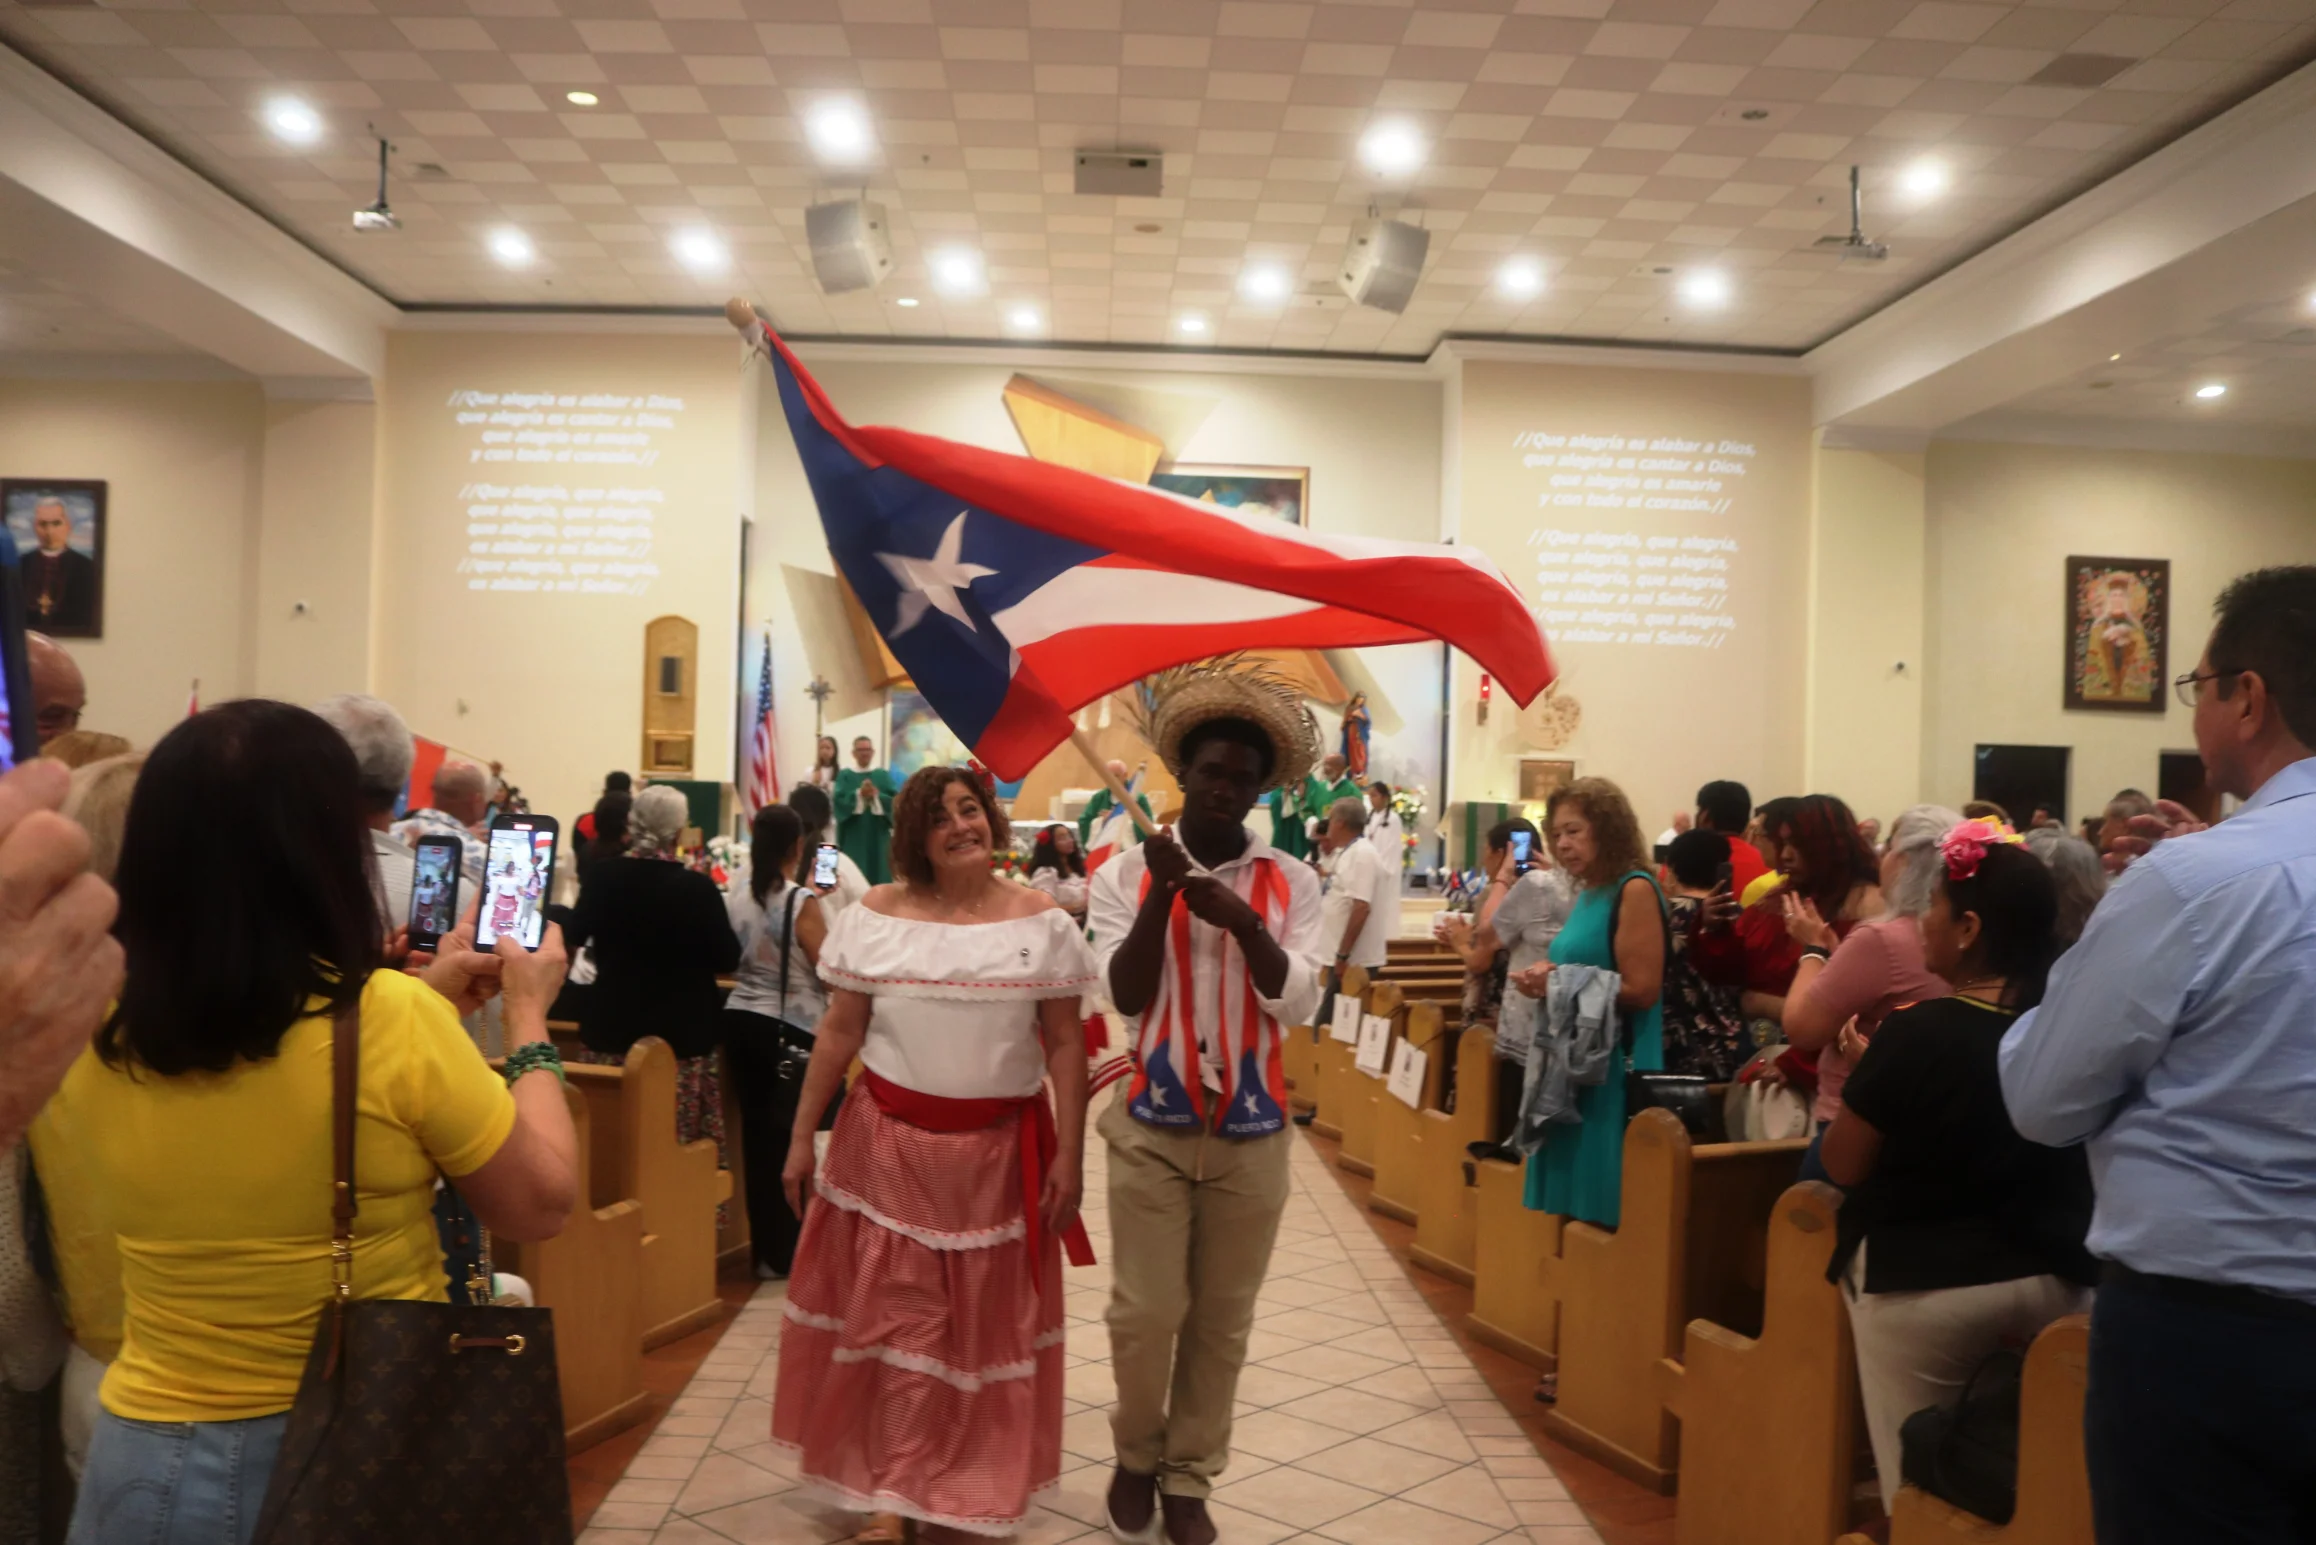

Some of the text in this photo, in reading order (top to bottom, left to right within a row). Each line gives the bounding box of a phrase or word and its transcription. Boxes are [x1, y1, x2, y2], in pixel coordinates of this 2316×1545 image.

[1703, 442, 1714, 453] a
[1693, 461, 1704, 472] a
[1538, 494, 1550, 507] y
[1552, 494, 1582, 506] con
[1617, 593, 1629, 604] a
[1616, 631, 1628, 643] a
